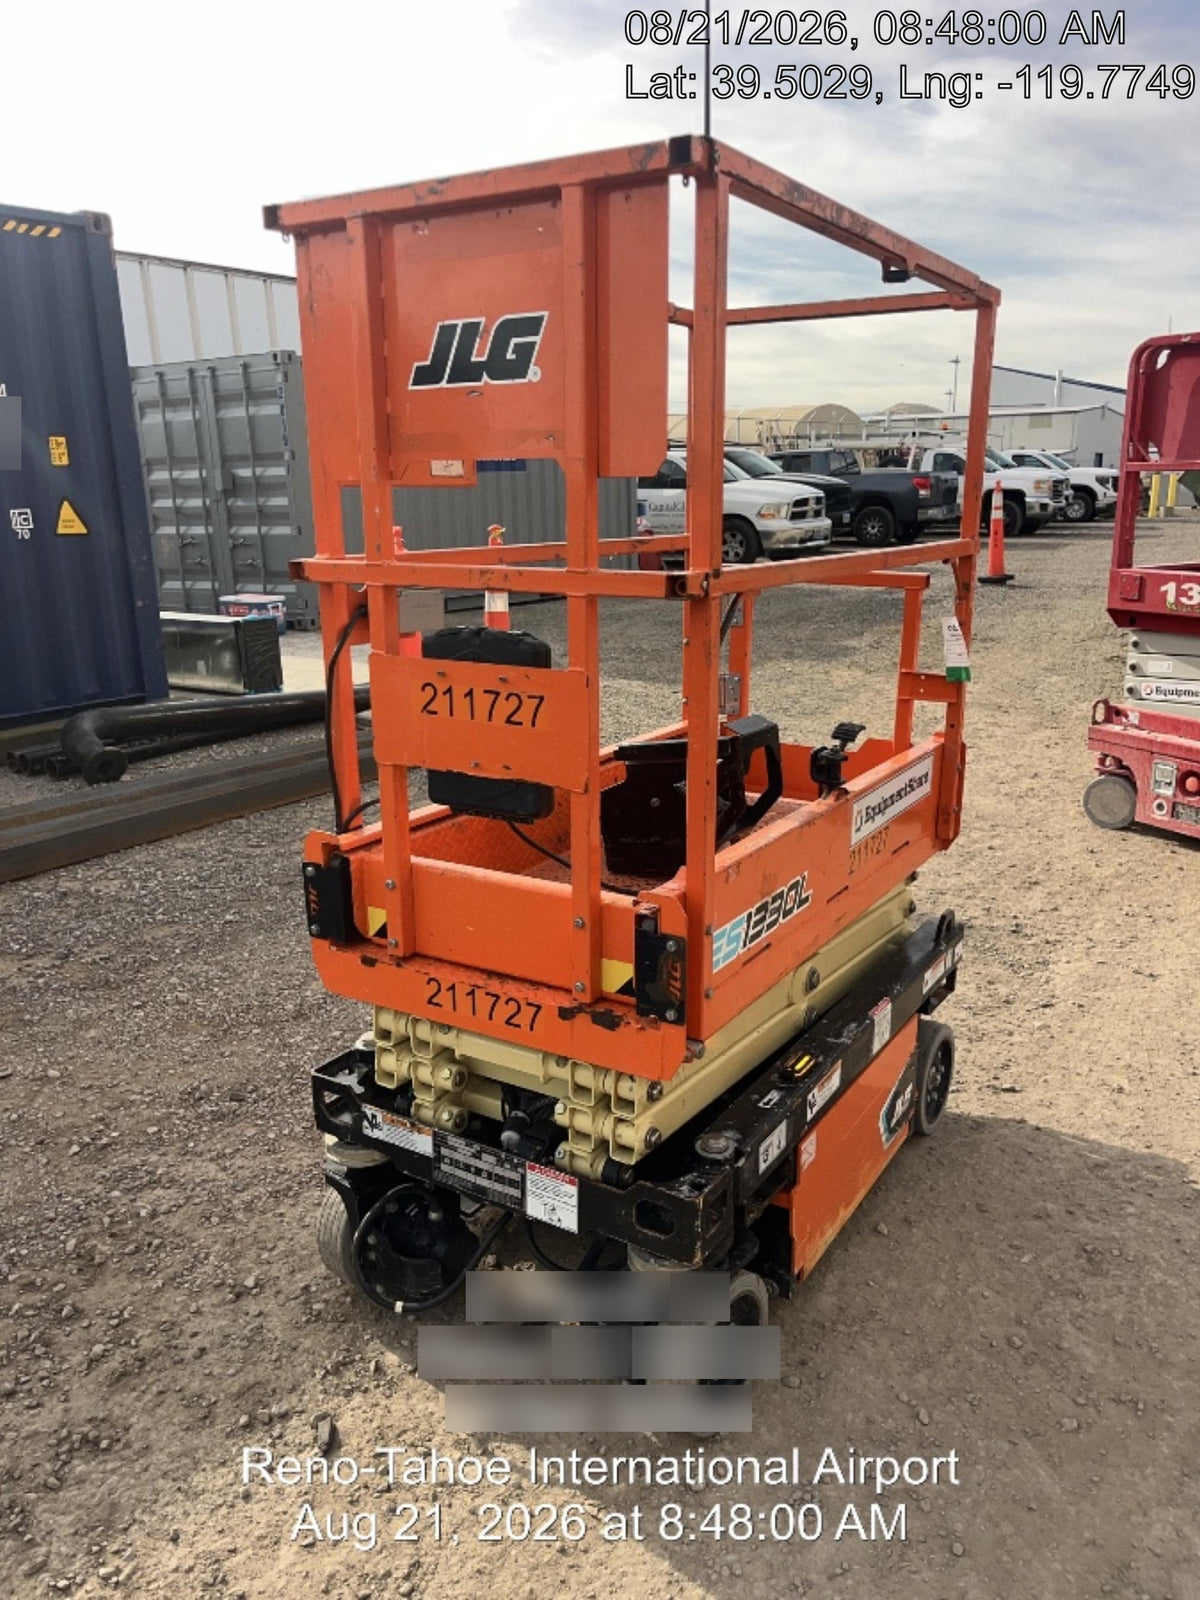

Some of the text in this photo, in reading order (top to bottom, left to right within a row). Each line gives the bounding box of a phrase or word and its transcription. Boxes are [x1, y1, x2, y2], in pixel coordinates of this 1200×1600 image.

[409, 311, 549, 390] JLG
[420, 682, 545, 728] 211727
[426, 977, 543, 1032] 211727
